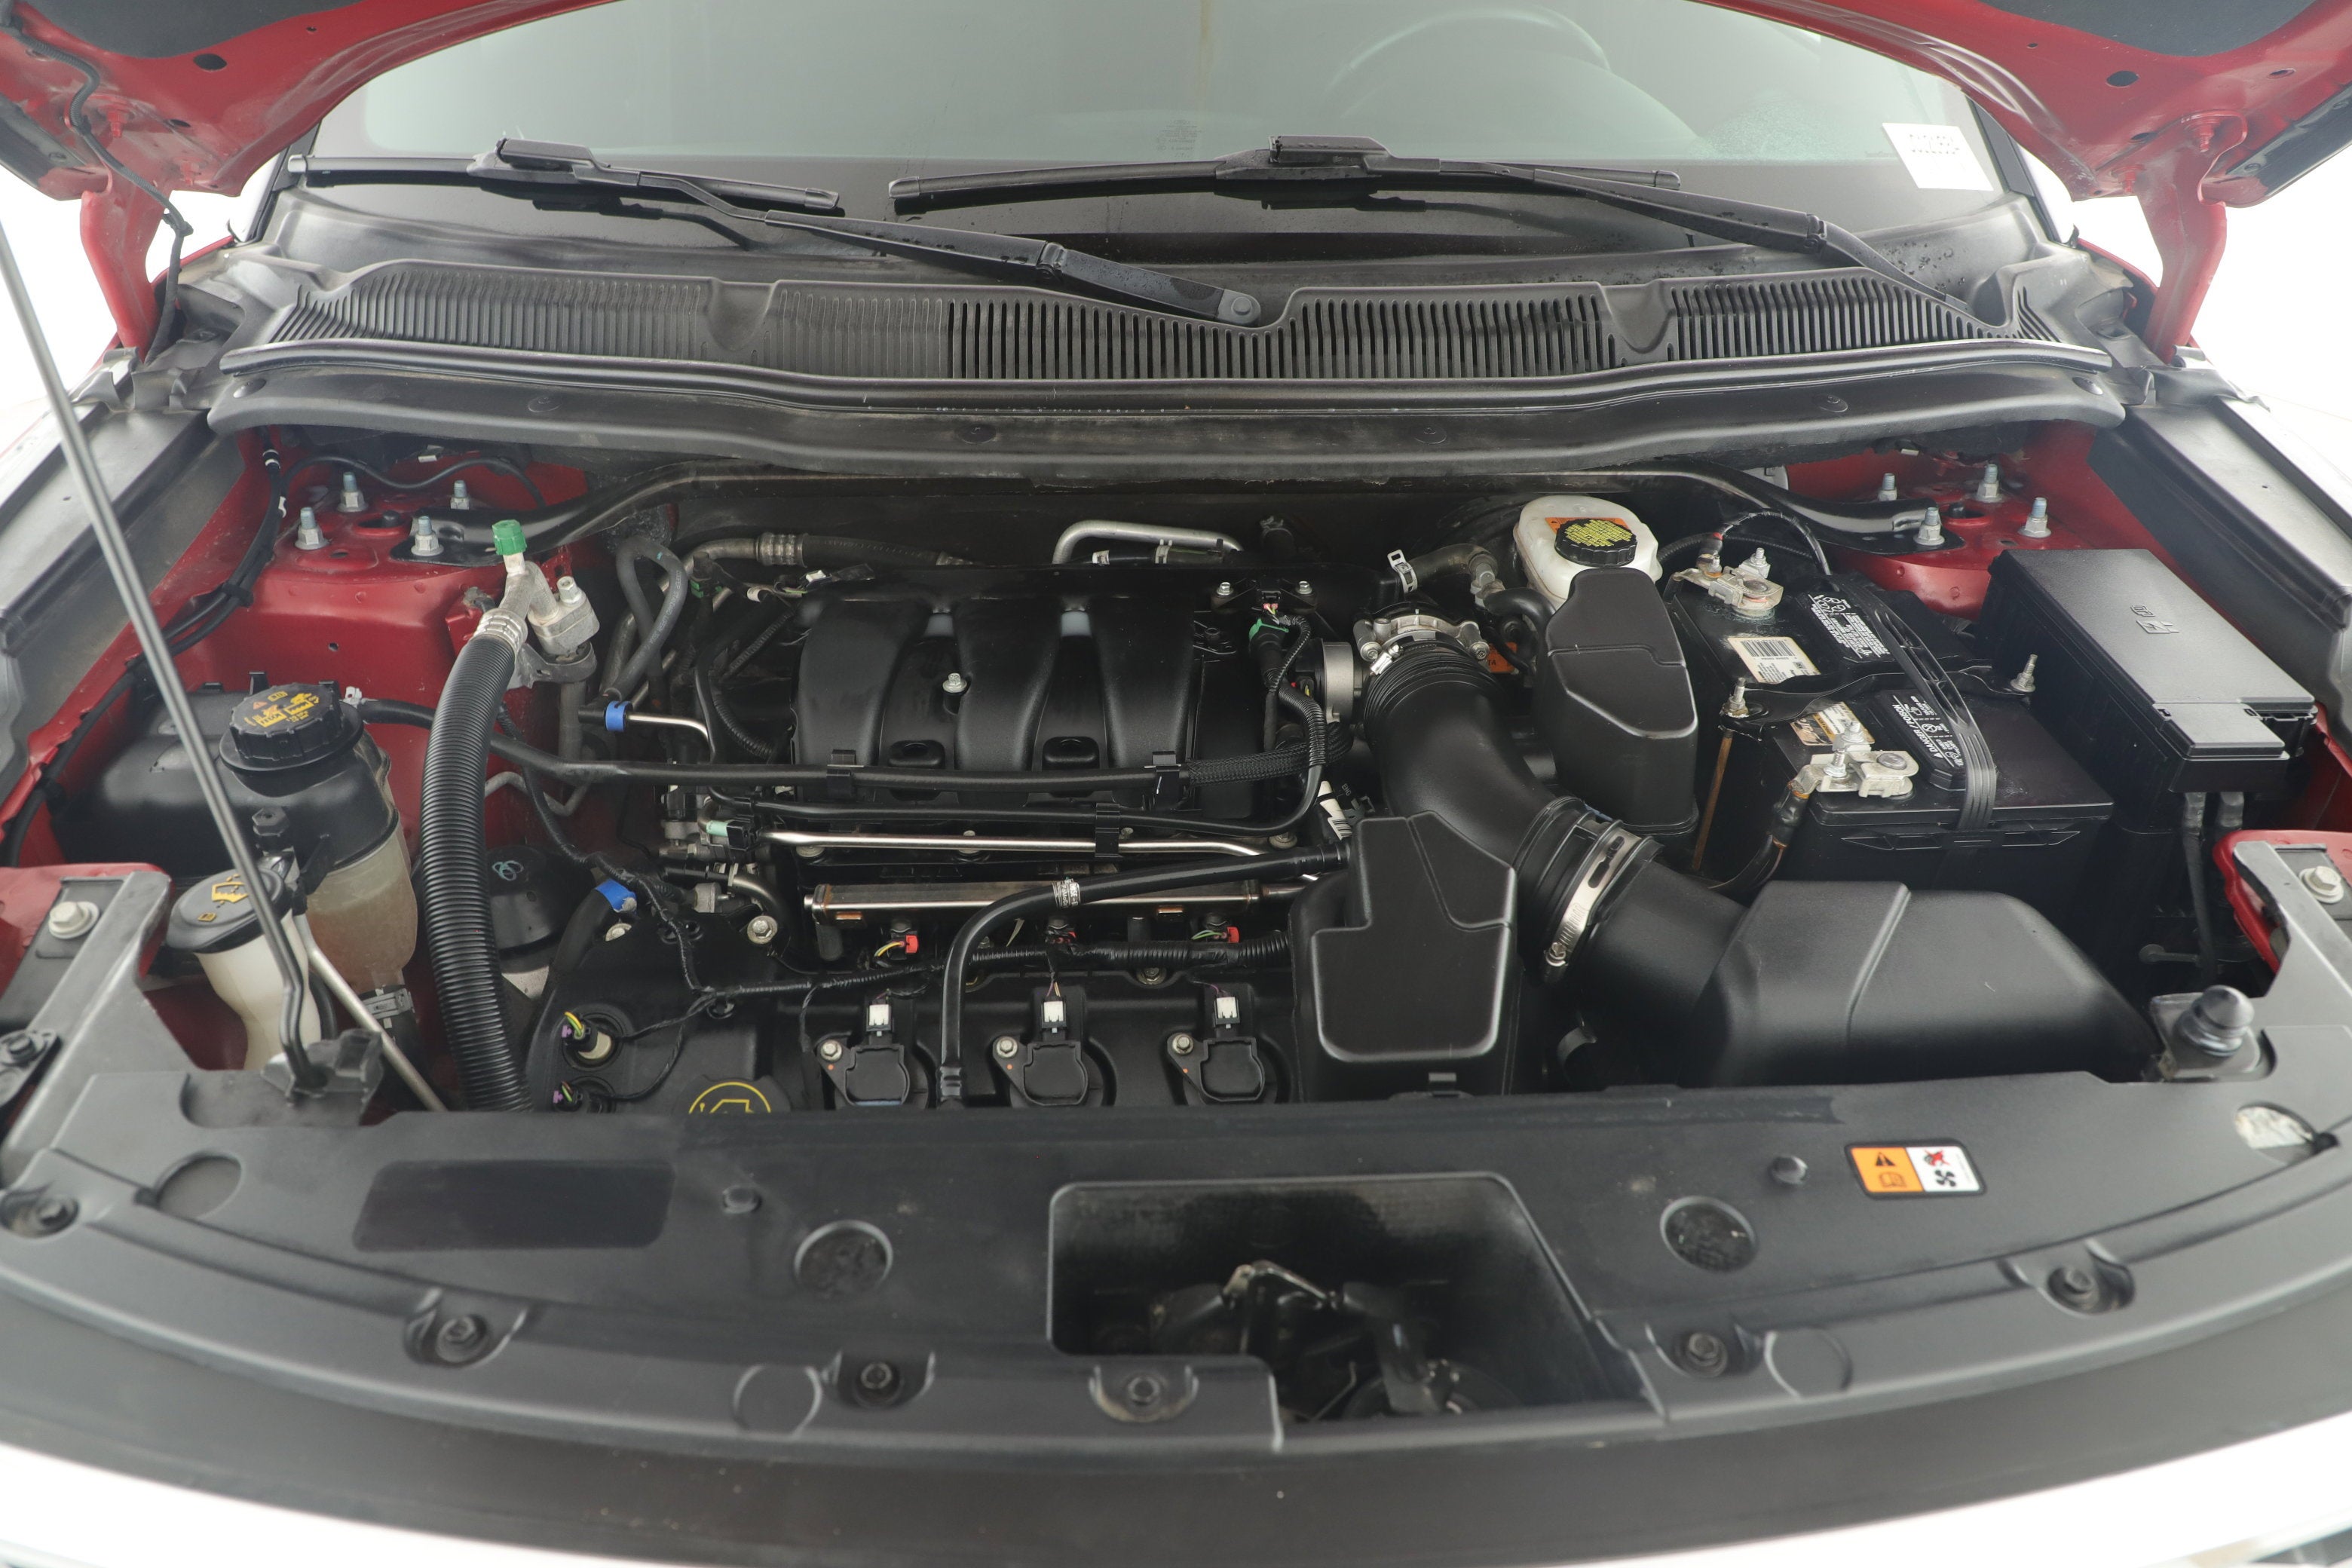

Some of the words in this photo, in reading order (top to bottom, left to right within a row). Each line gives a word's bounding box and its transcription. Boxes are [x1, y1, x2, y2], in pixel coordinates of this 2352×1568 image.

[1892, 704, 1915, 724] POISON
[1913, 729, 1938, 752] DANGER
[1341, 782, 1352, 796] ENG
